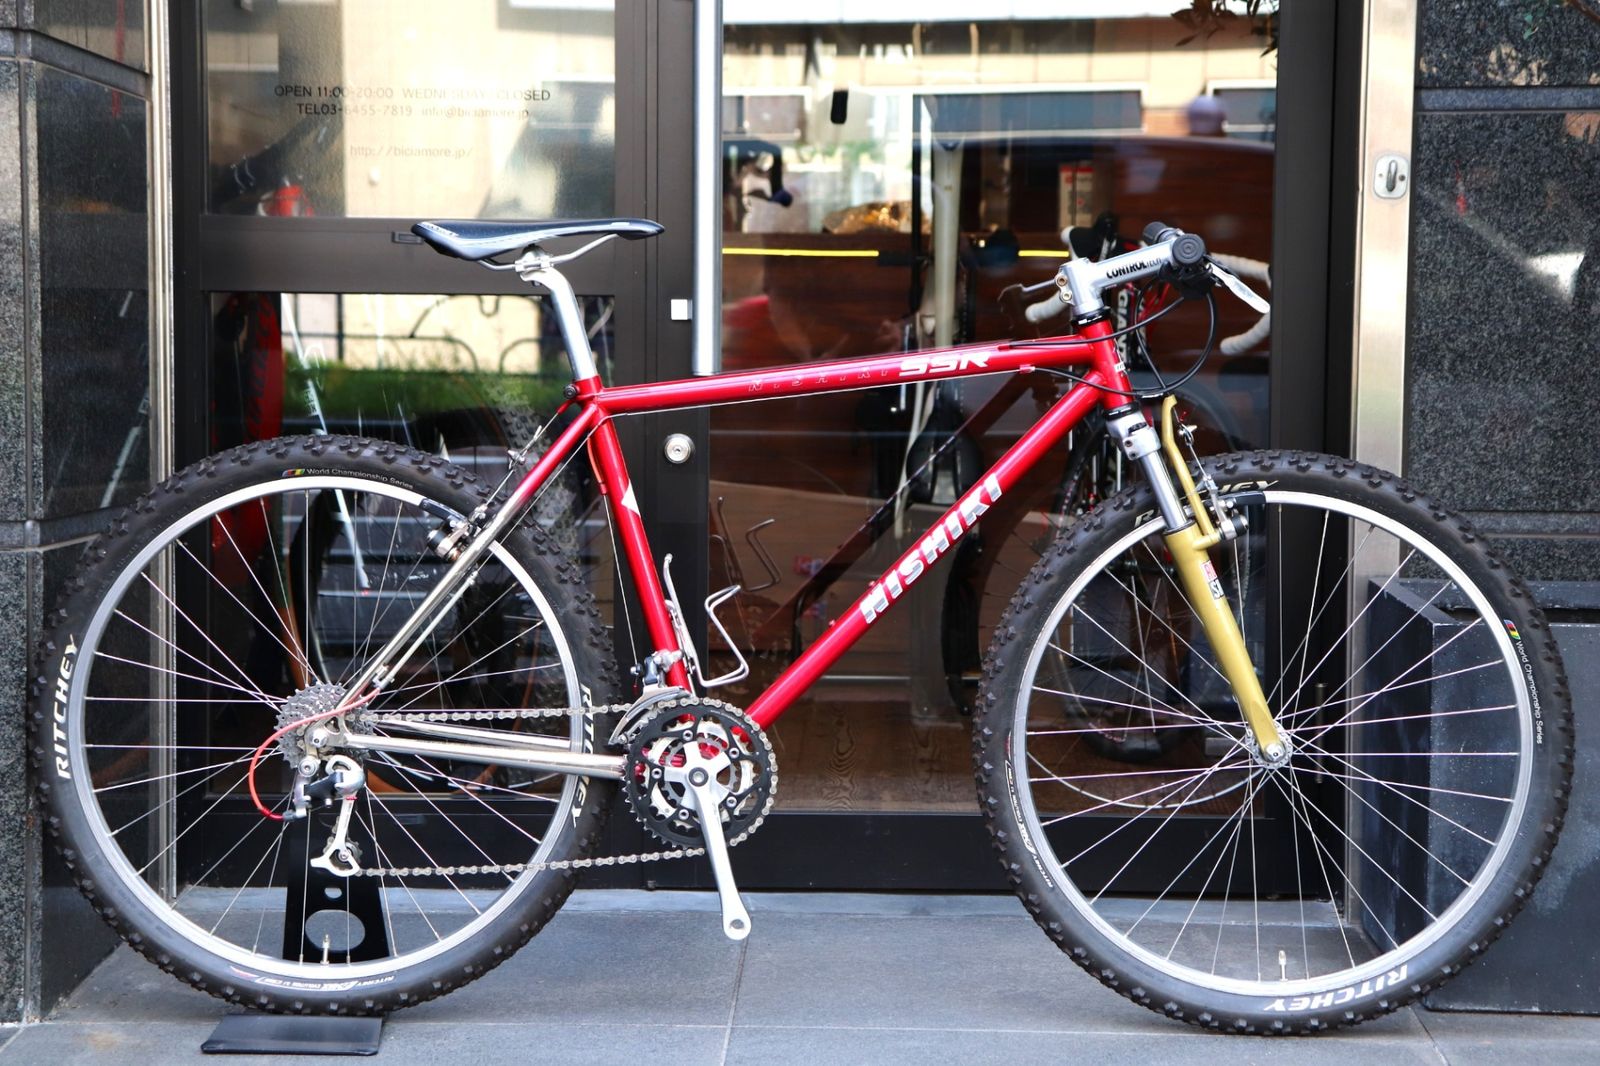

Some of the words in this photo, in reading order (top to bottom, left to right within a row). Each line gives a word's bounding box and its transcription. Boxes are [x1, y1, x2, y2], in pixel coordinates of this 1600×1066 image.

[274, 85, 312, 97] OPEN
[898, 351, 993, 377] SSR
[306, 467, 330, 476] World
[331, 467, 388, 482] Championship
[389, 477, 414, 490] Series
[859, 472, 1003, 624] NISHIKI
[53, 633, 78, 780] RITCHEY
[1515, 640, 1529, 663] World
[1524, 663, 1541, 719] Championship
[1535, 719, 1544, 745] Series
[1263, 964, 1408, 1012] RITCHEY
